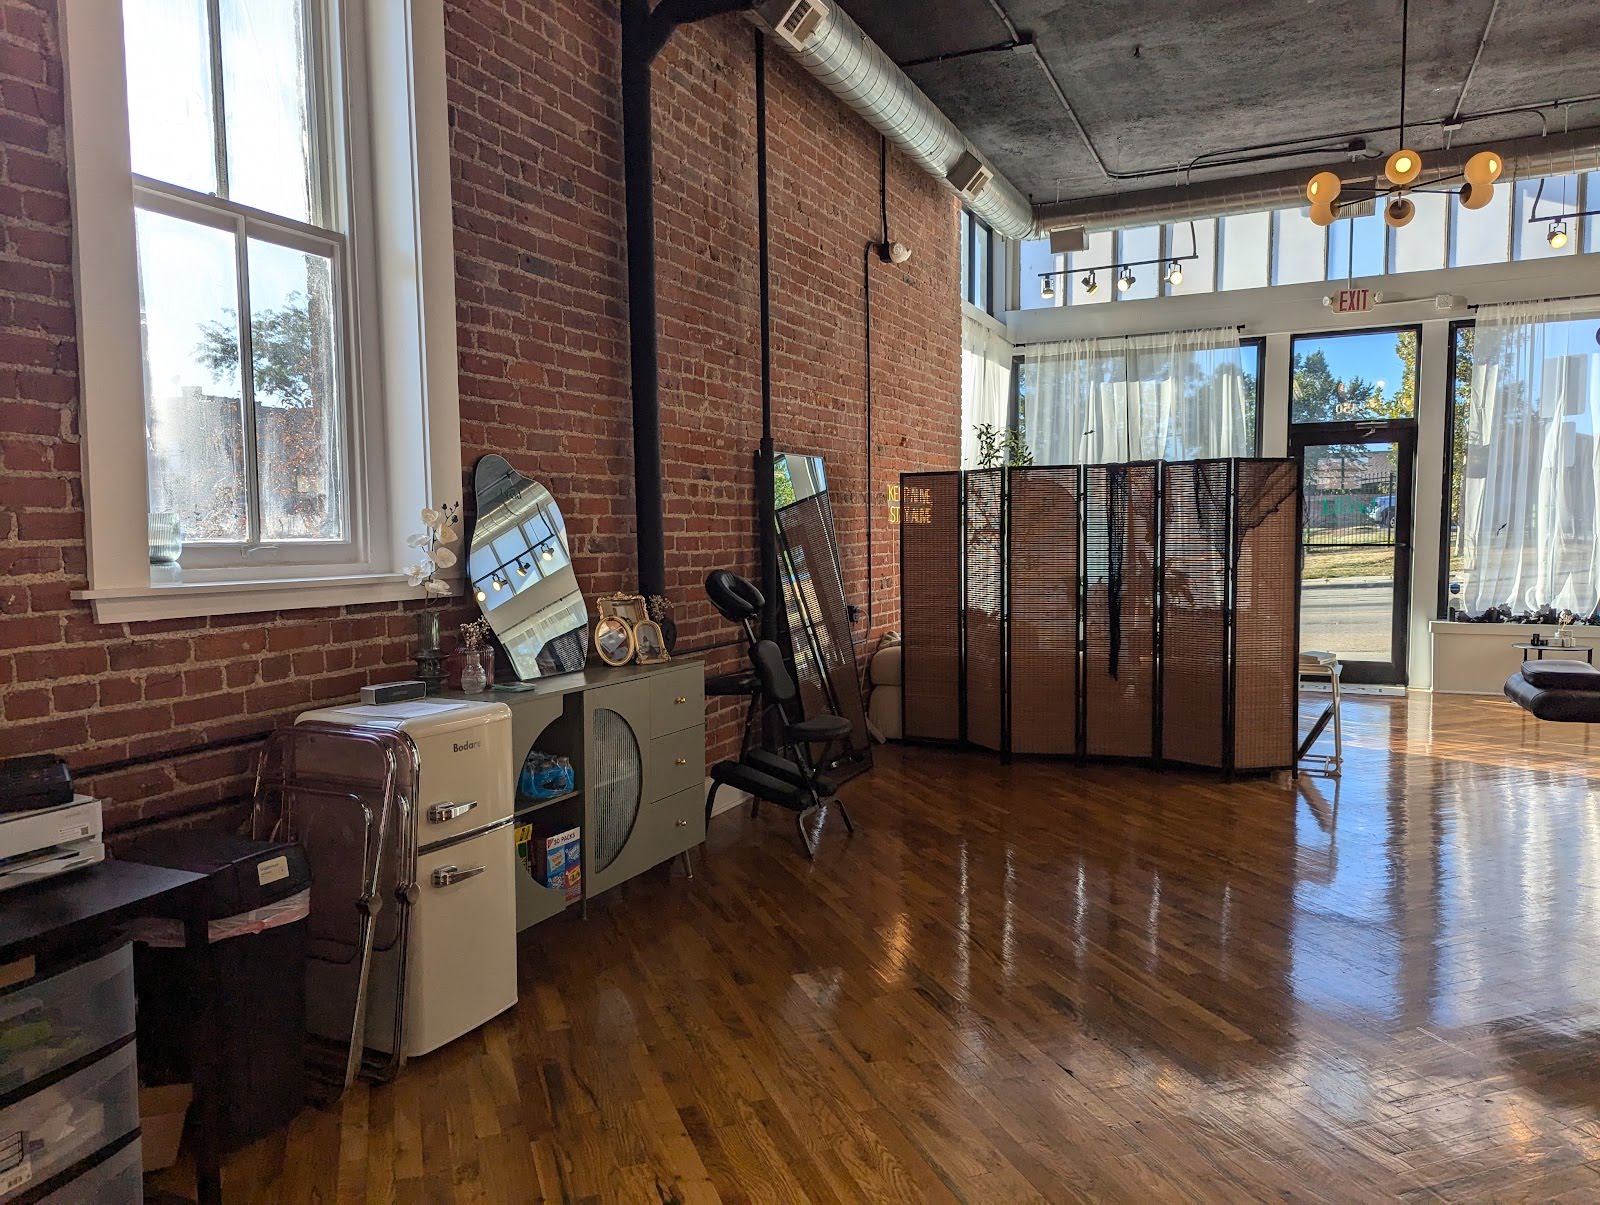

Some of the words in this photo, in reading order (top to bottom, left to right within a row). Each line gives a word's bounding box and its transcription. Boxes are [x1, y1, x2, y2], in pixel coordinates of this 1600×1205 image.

[1339, 289, 1369, 312] EXIT
[887, 484, 910, 503] KEP
[888, 506, 910, 523] STY
